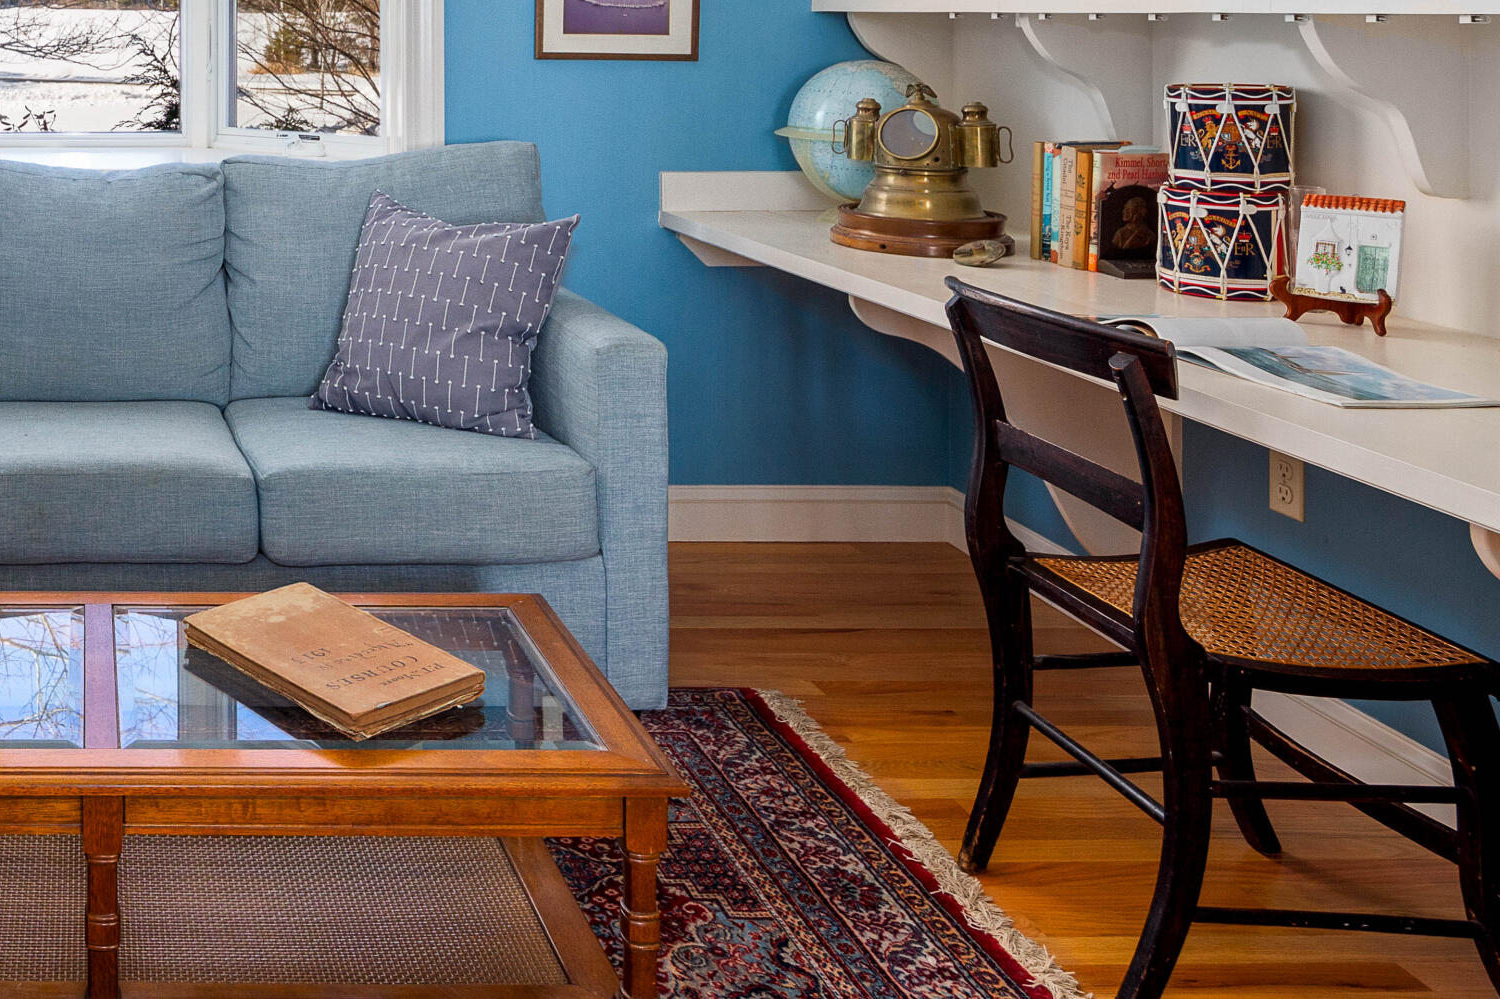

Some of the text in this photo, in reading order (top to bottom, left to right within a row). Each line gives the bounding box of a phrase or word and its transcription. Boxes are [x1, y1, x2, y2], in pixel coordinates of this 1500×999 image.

[1115, 157, 1145, 169] Kimmel,
[1107, 169, 1122, 180] and
[1122, 169, 1141, 180] Pearl
[326, 655, 419, 690] COURSES
